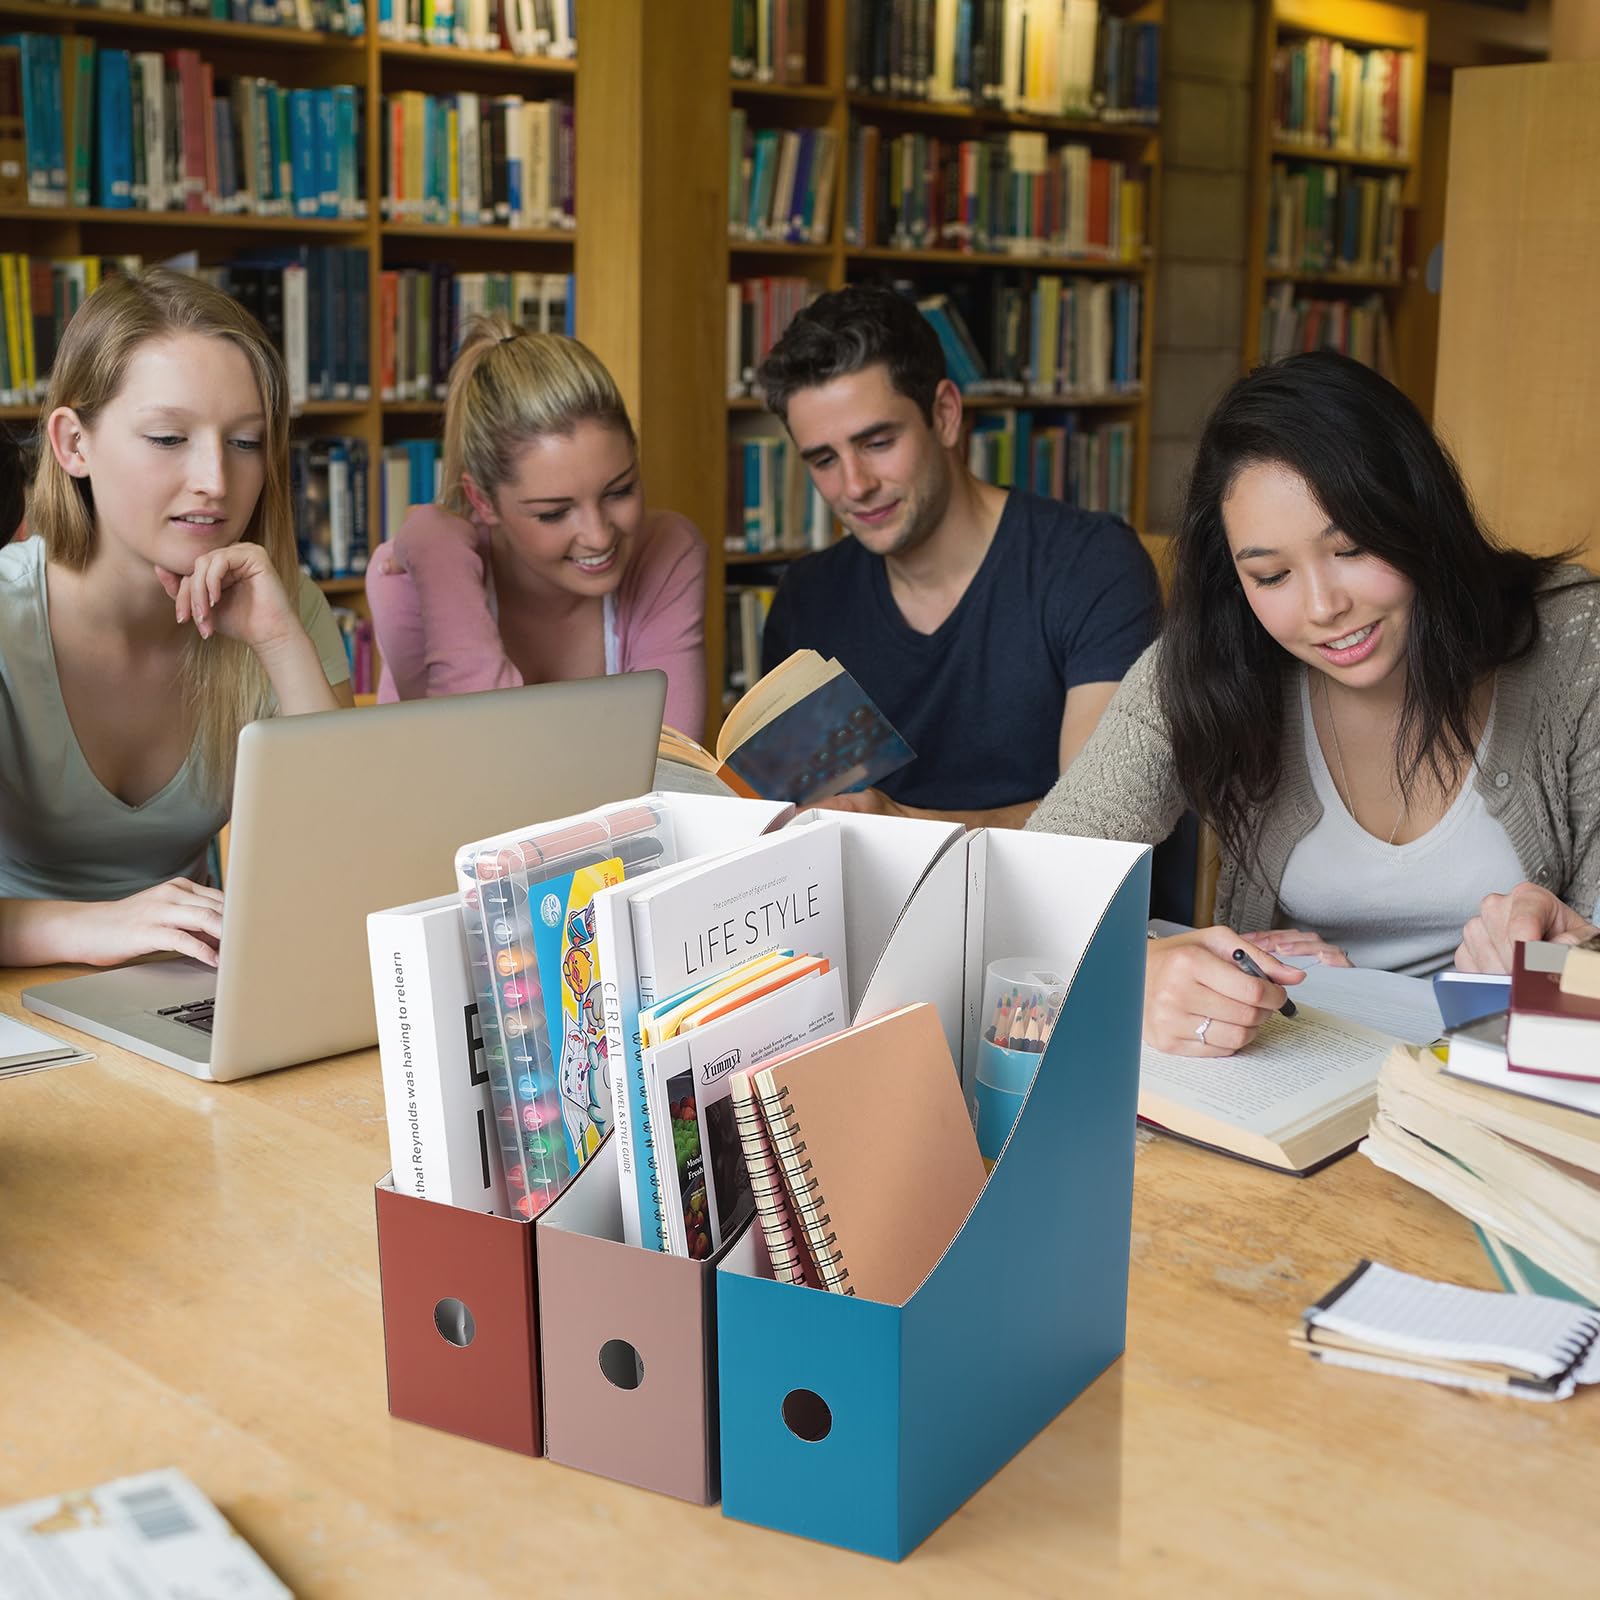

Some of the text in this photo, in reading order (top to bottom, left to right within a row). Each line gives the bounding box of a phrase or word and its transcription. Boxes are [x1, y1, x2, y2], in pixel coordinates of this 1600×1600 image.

[684, 883, 820, 975] LIFE STYLE
[393, 951, 406, 1003] relearn
[640, 975, 655, 1008] LIF
[398, 1006, 408, 1020] to
[603, 982, 622, 1061] CEREAL
[400, 1022, 413, 1068] having
[405, 1071, 416, 1099] was
[408, 1101, 423, 1164] Reynolds
[615, 1077, 632, 1174] TRAVEL & STYLE GUIDE
[414, 1167, 426, 1193] that
